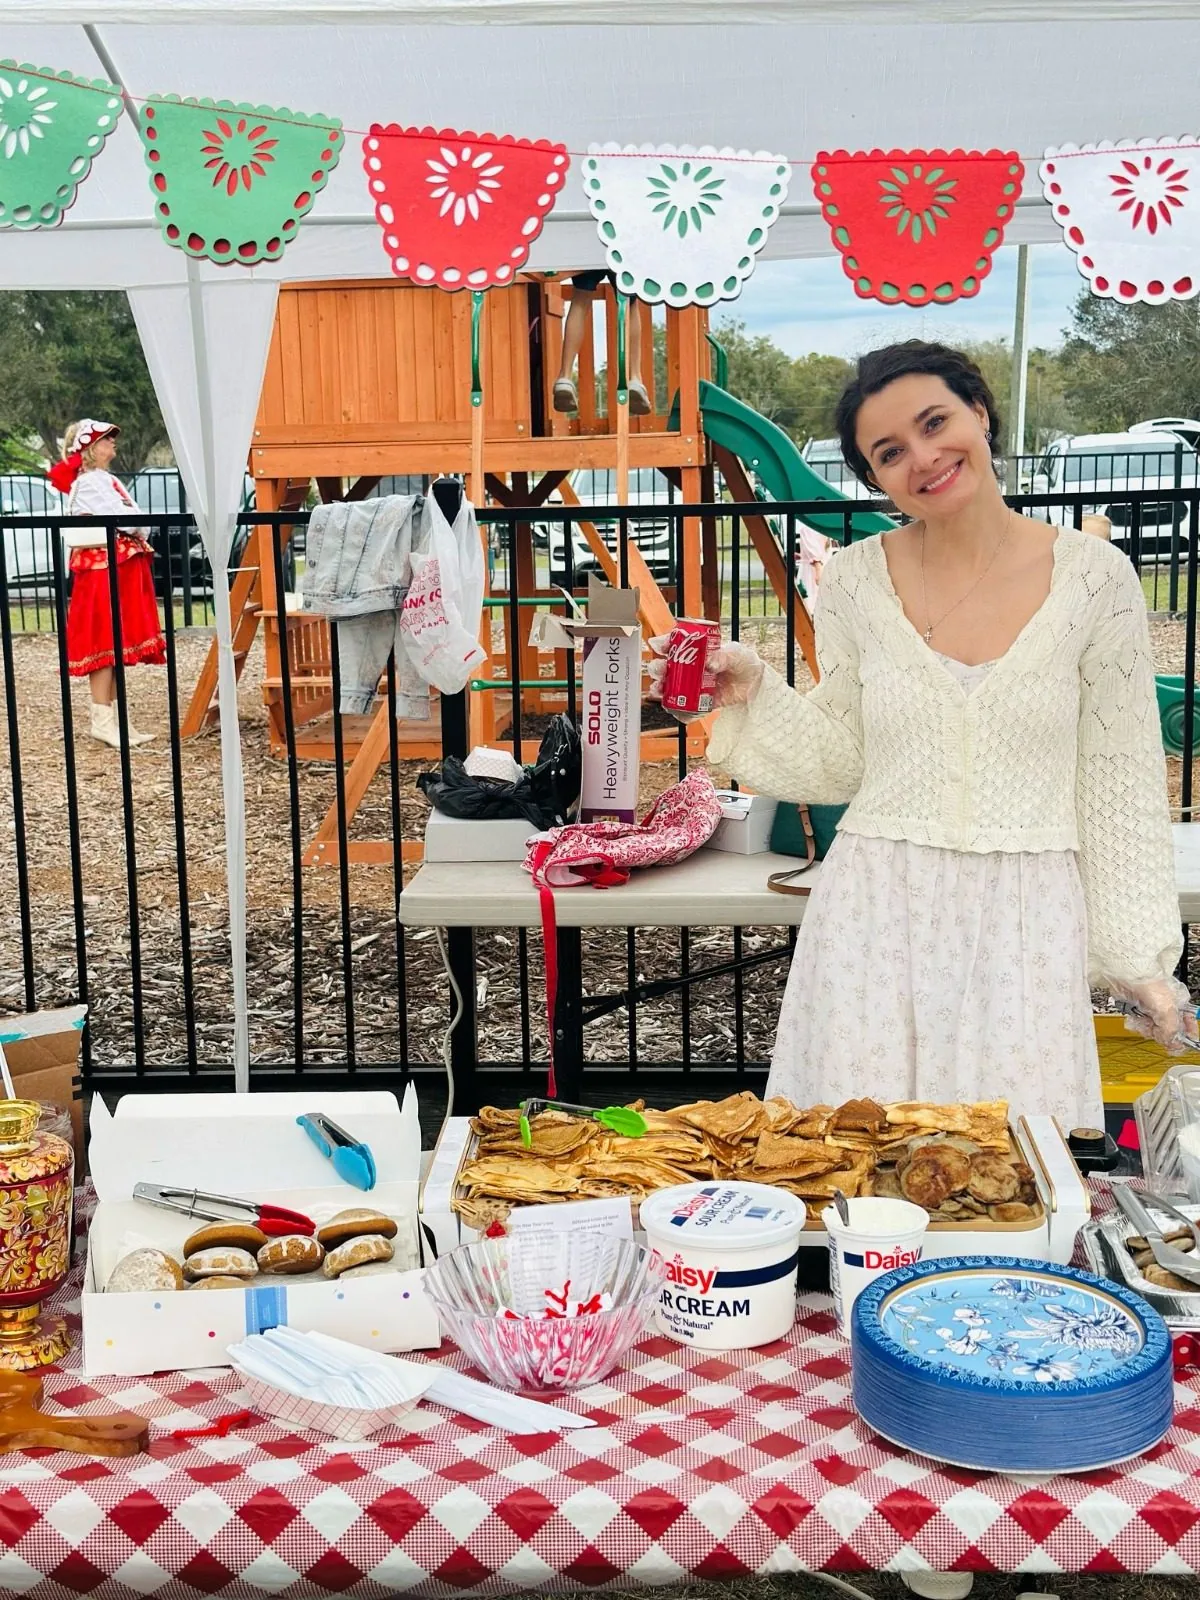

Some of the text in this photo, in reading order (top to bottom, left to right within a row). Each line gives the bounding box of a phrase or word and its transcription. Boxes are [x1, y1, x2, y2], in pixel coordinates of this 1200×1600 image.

[588, 691, 601, 745] SOLO
[603, 637, 620, 799] Heavyweight Forks
[672, 1194, 714, 1217] Daisy
[696, 1190, 740, 1227] SOUR CREAM
[653, 1249, 715, 1294] aisy
[865, 1248, 918, 1269] Daisy
[676, 1295, 750, 1317] CREAM
